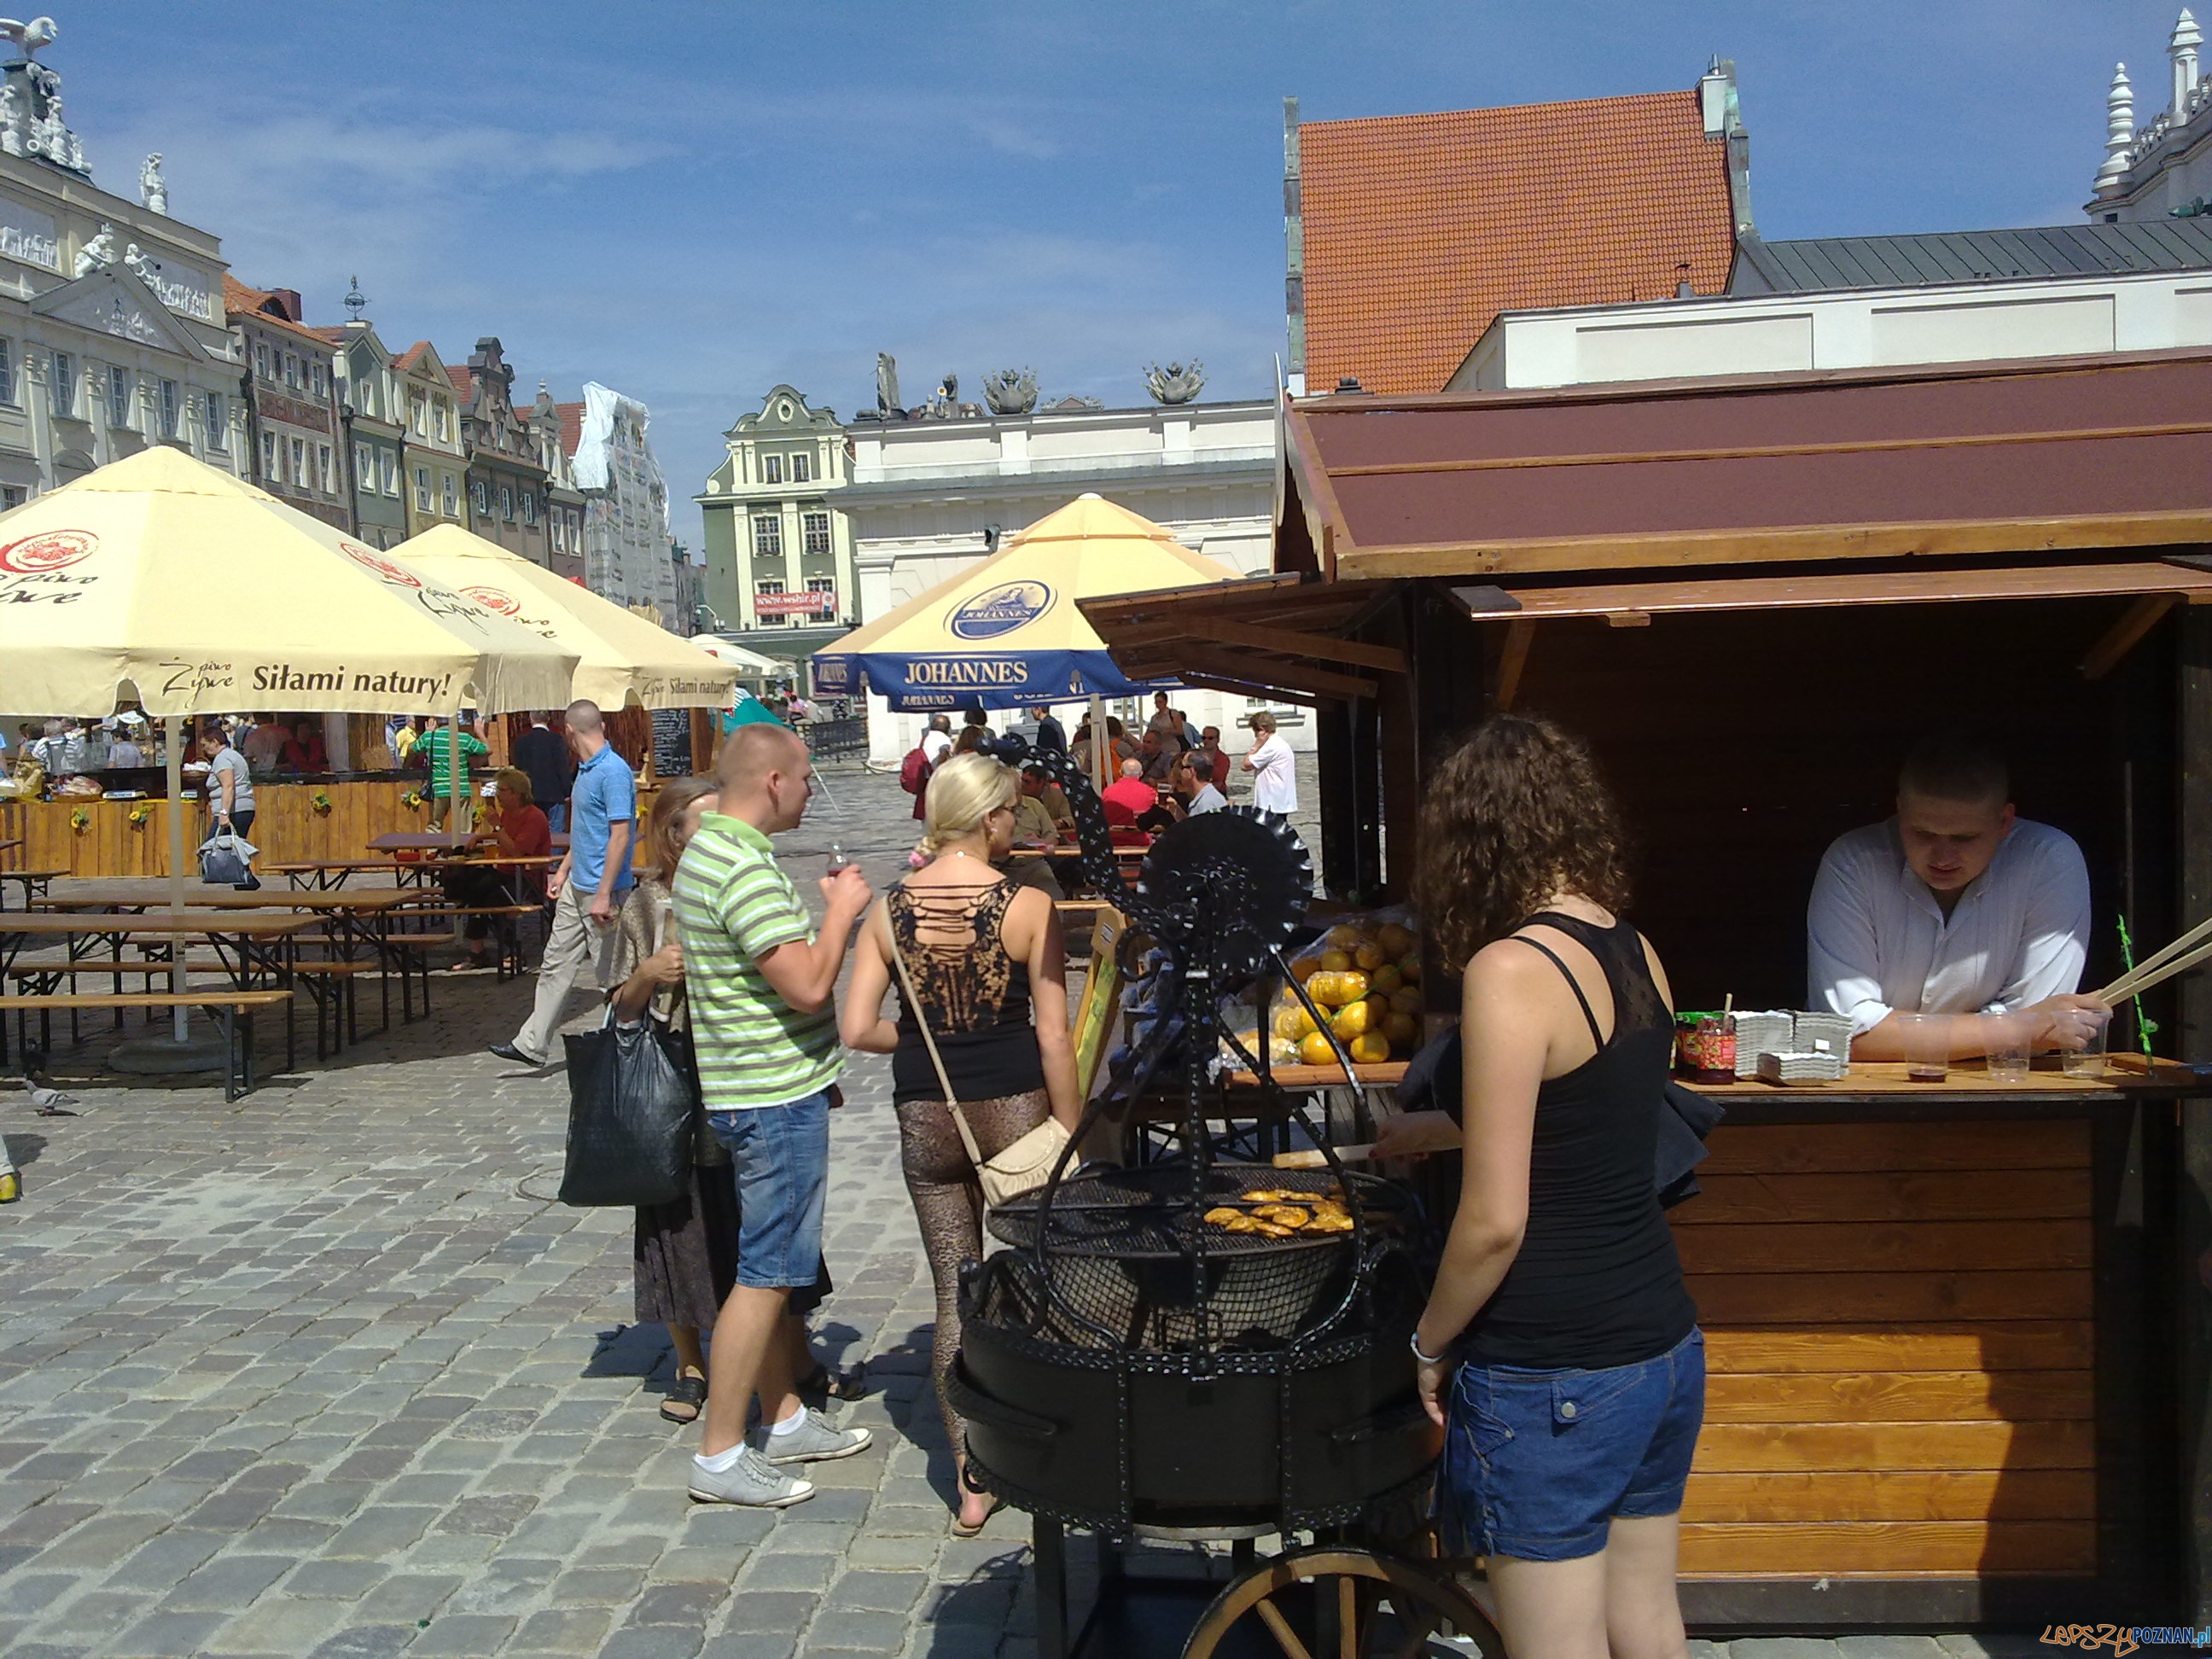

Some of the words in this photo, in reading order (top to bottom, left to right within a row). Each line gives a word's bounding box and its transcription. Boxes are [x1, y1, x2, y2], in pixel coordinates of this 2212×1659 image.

[253, 664, 345, 691] Siłami
[352, 670, 451, 704] natury!
[905, 661, 1028, 684] JOHANNES
